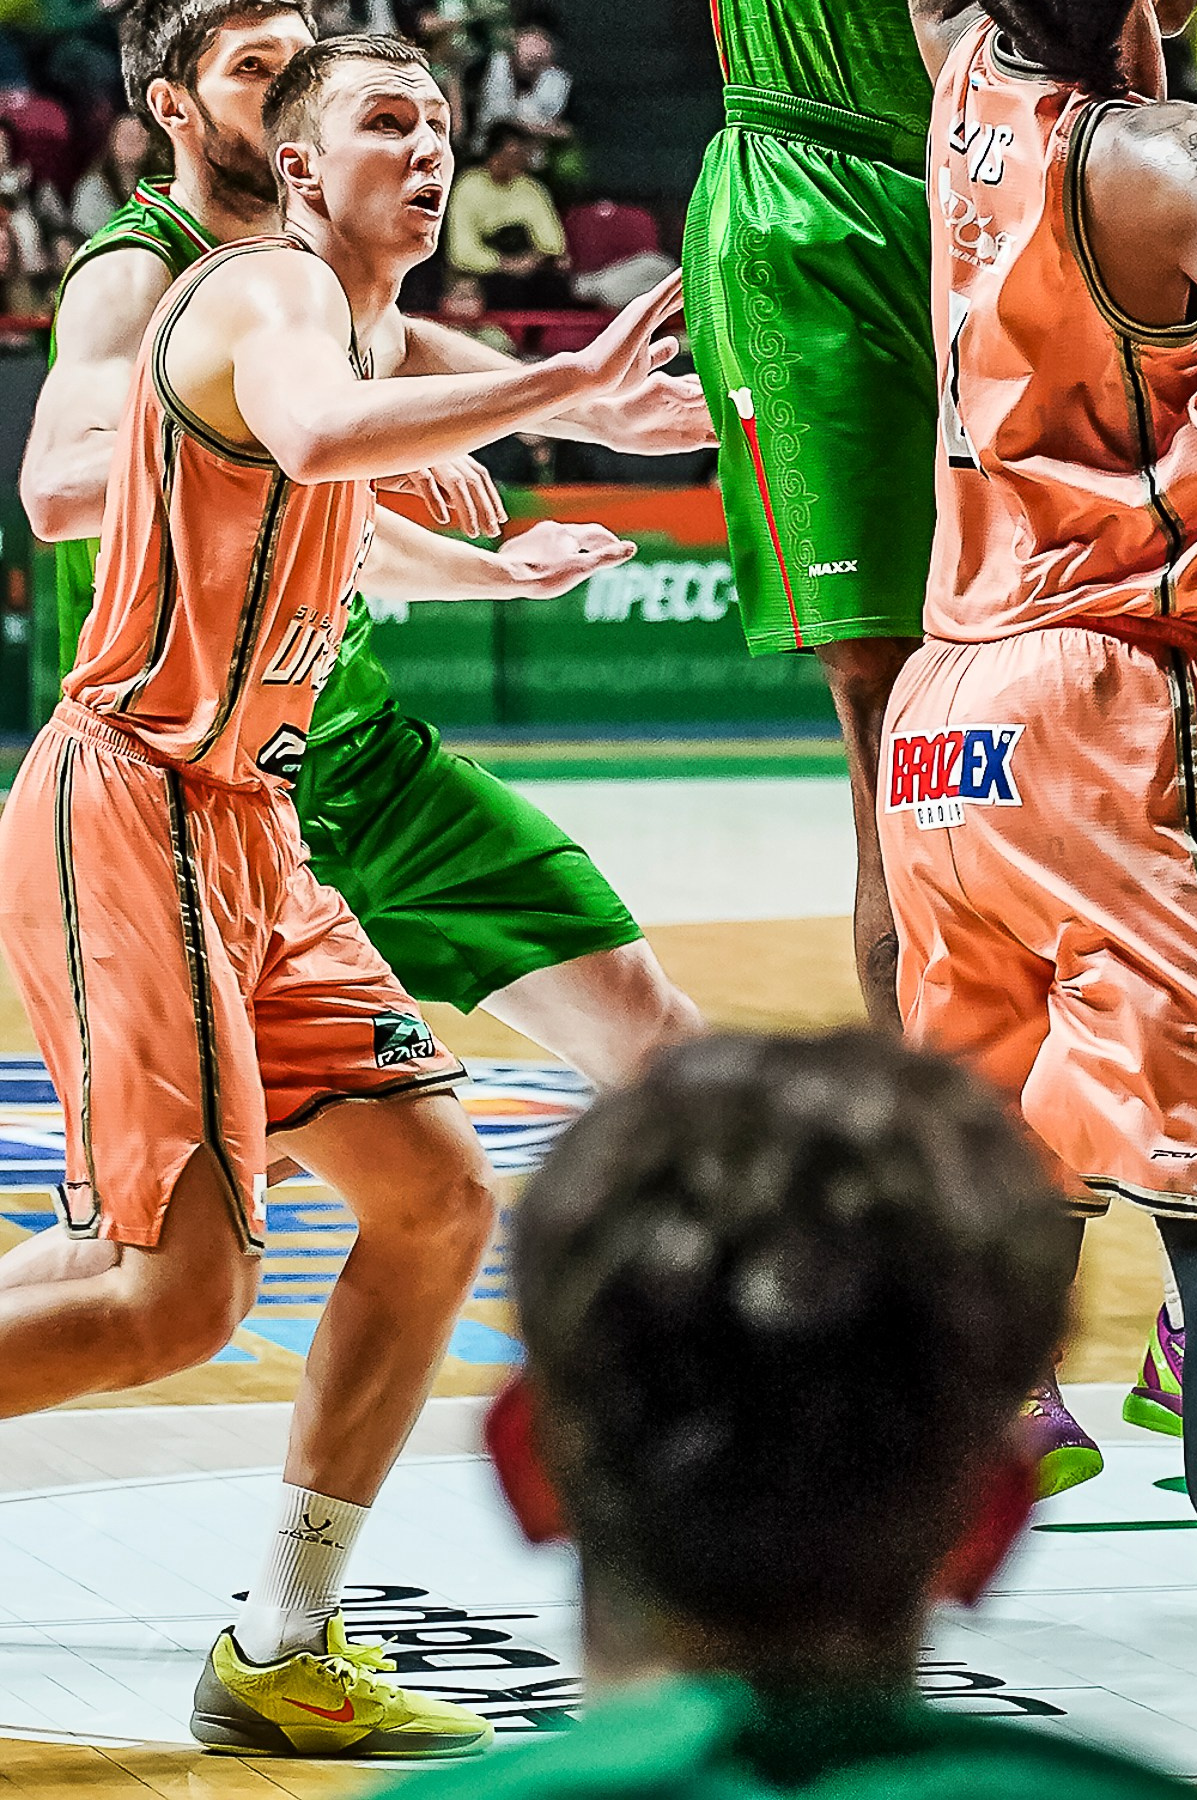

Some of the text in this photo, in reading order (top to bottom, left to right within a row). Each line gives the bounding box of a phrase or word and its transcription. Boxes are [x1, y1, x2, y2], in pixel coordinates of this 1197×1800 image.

[808, 559, 858, 578] MAXX
[890, 729, 1016, 807] BROZEX
[377, 1039, 434, 1067] PARI
